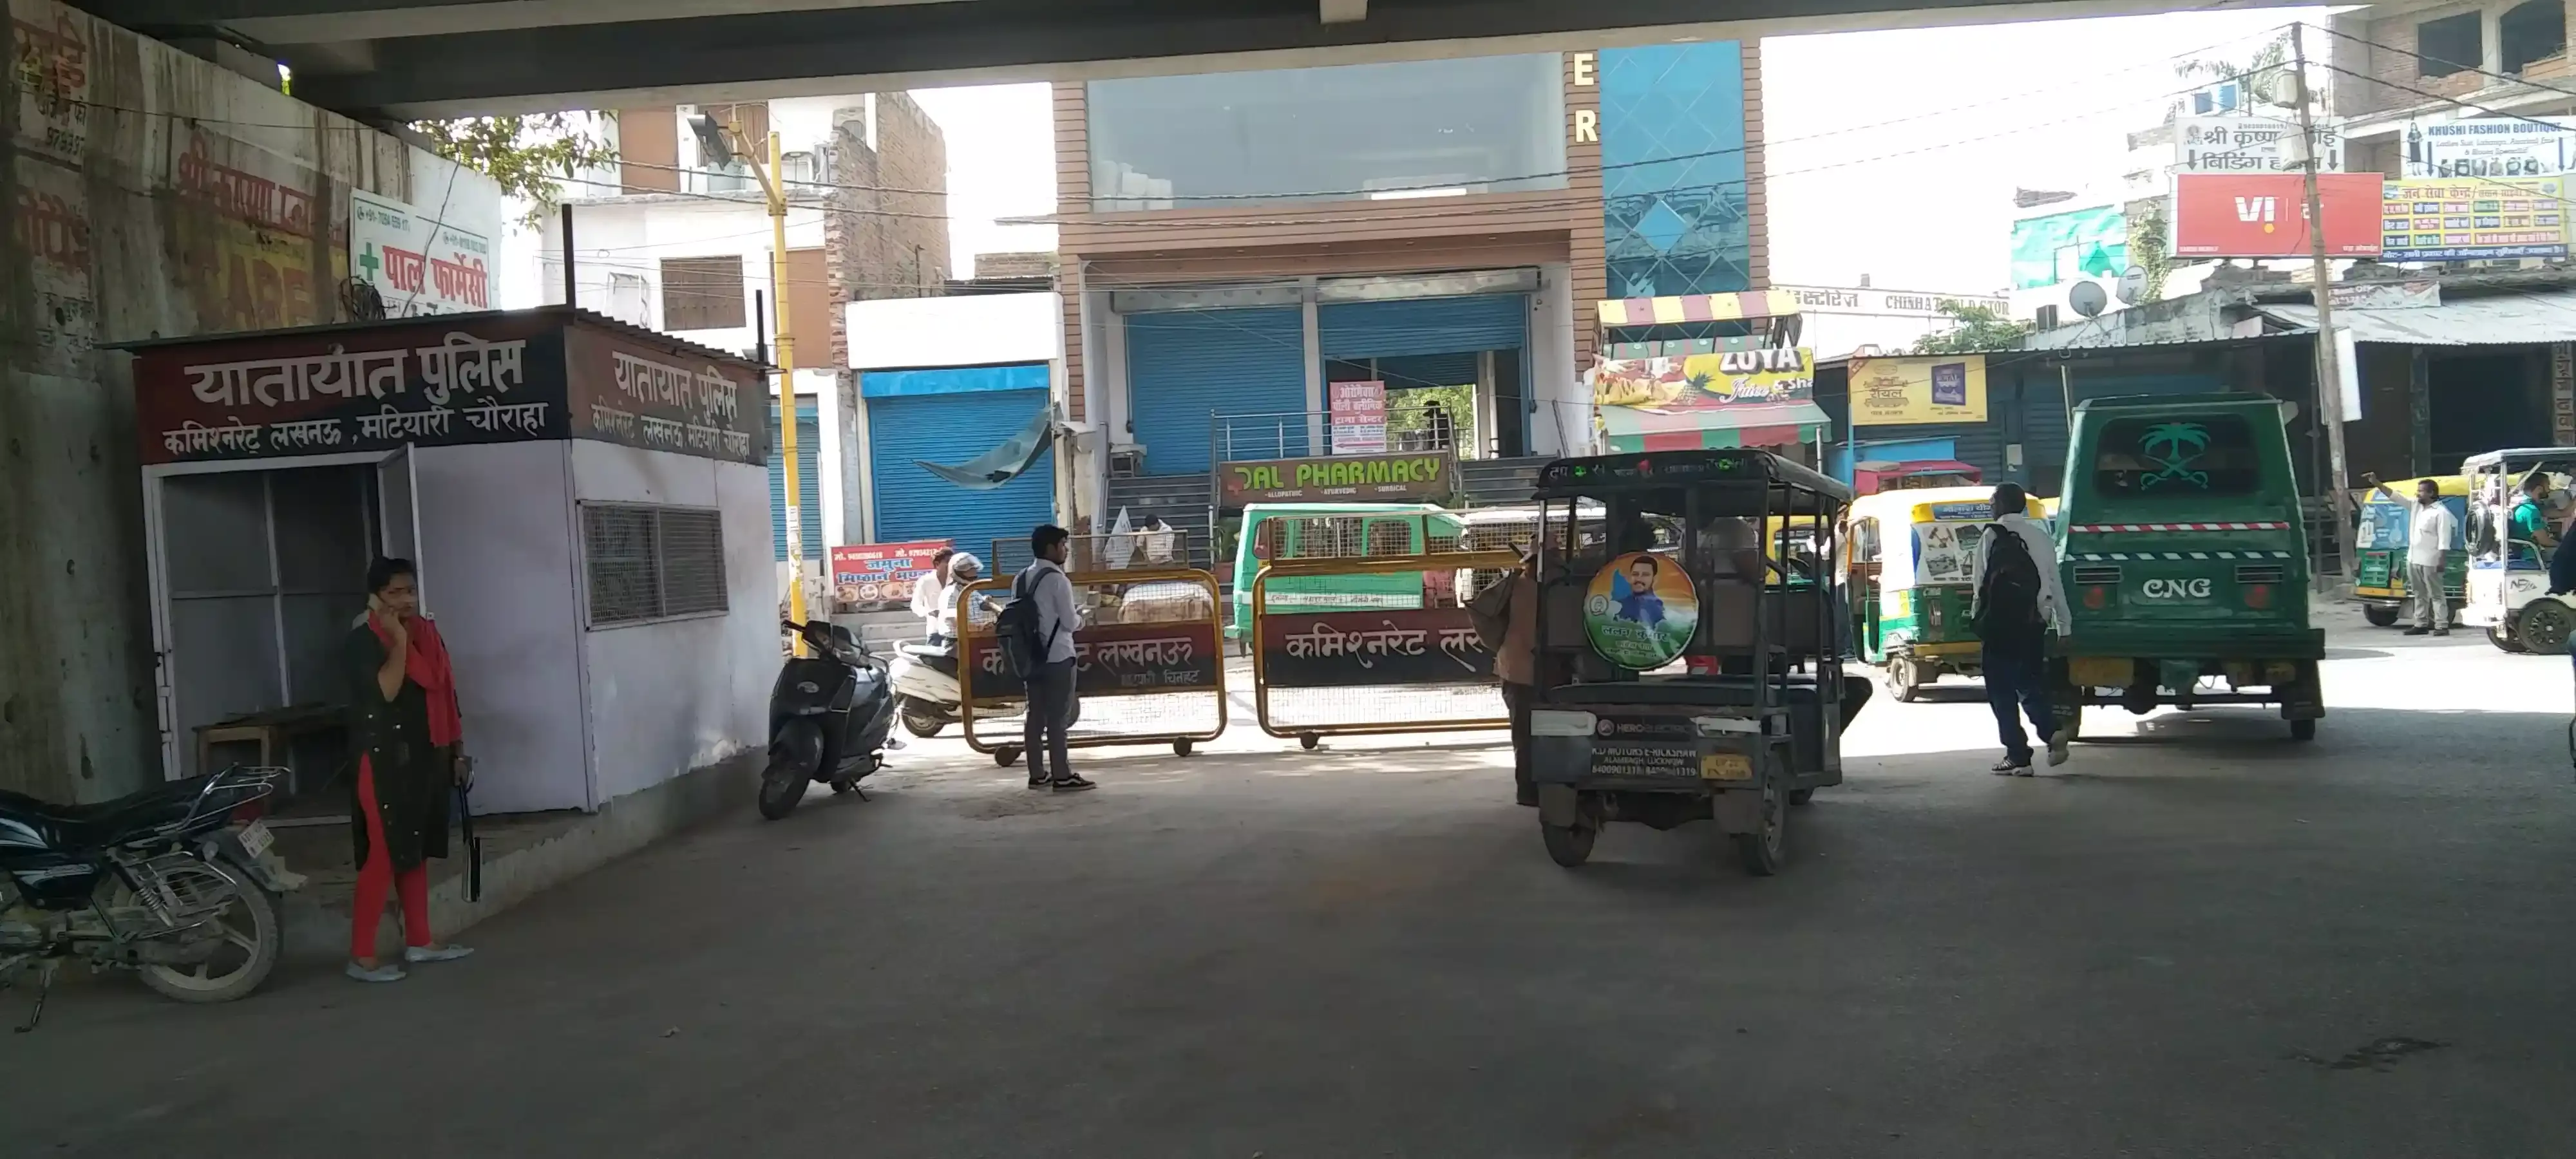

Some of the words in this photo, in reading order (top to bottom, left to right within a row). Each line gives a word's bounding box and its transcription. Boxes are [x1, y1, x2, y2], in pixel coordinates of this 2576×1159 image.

[2203, 126, 2228, 144] श्री
[2429, 126, 2466, 136] KHUSHI
[2468, 124, 2510, 135] FASHION
[2513, 122, 2562, 133] BOUTIQUE
[381, 245, 426, 295] पाल
[1803, 290, 1859, 308] स्टोरेज
[184, 348, 409, 408] यातायात
[415, 332, 527, 405] पुलिस
[612, 350, 694, 412] यातायात
[696, 364, 737, 424] पुलिस
[462, 396, 549, 438] चौराहा
[1296, 458, 1441, 487] PHARMACY
[2143, 578, 2212, 598] CNG
[1097, 637, 1192, 677] लखनऊ
[1285, 619, 1428, 669] कमिश्नरेट
